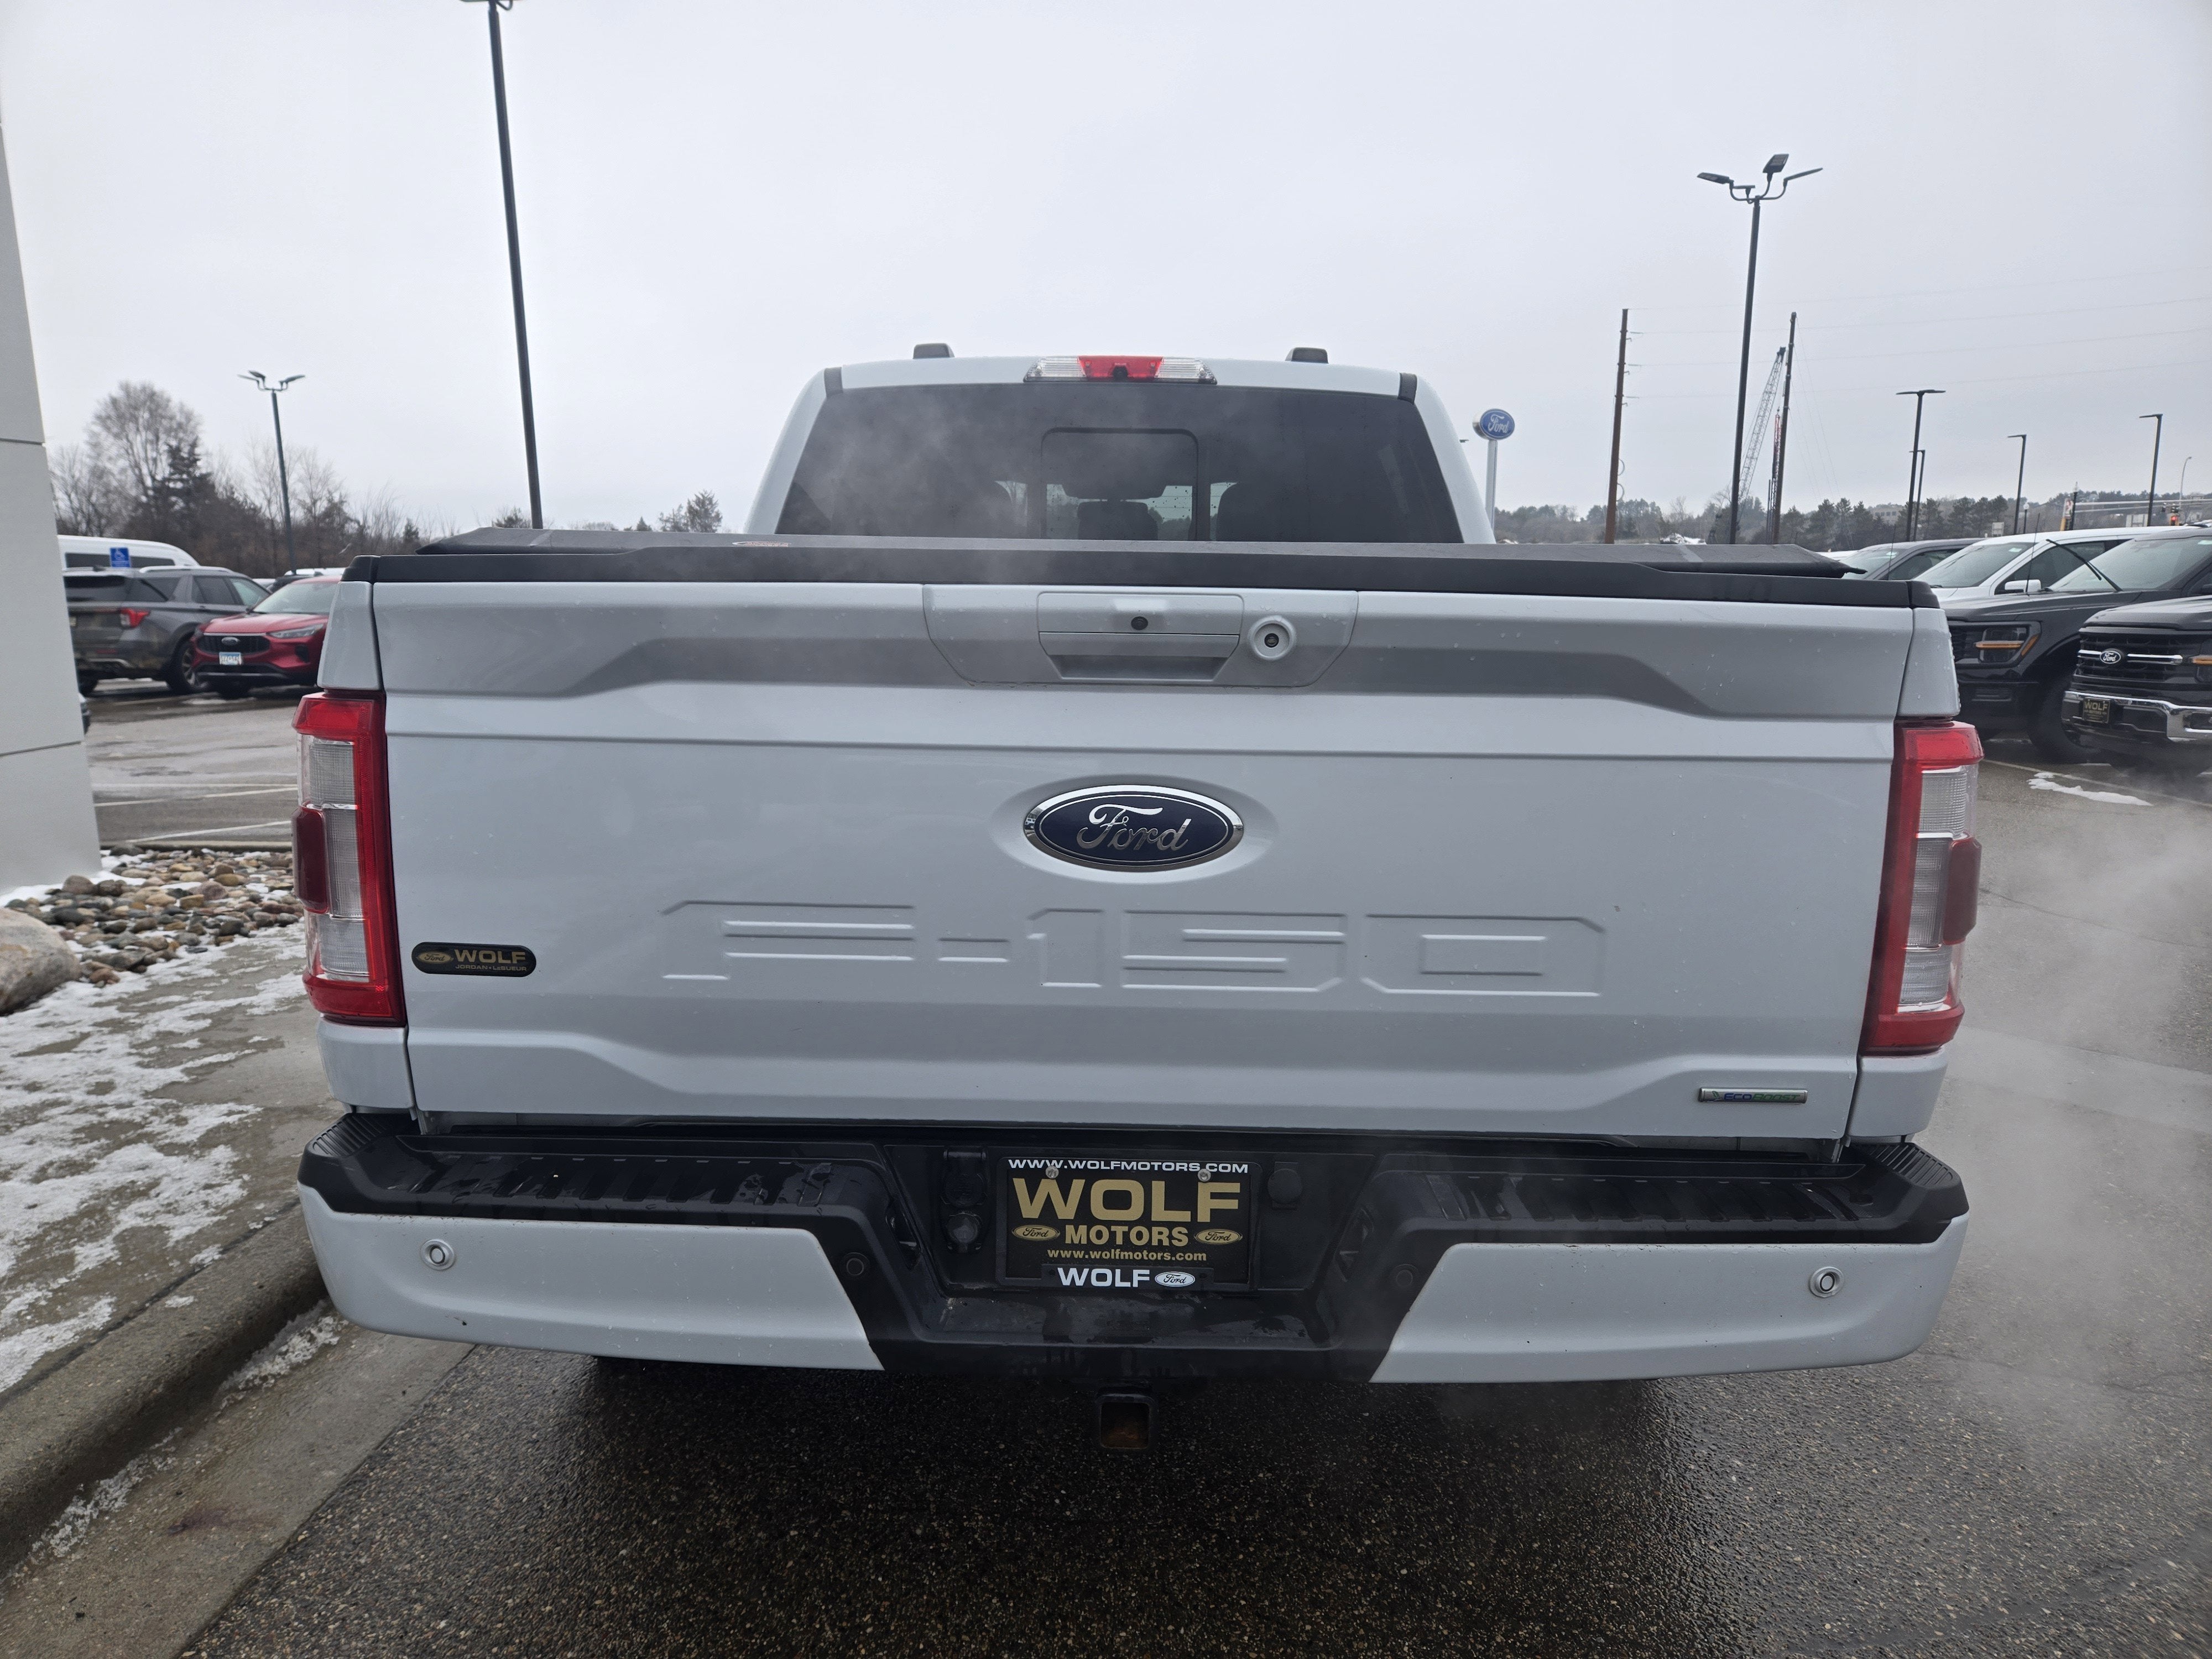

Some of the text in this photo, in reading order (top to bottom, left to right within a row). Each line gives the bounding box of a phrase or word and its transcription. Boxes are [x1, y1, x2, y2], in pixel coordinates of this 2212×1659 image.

[1488, 414, 1510, 433] Ford
[2103, 652, 2117, 661] Ford
[2085, 701, 2108, 711] WOLF
[1076, 804, 1192, 851] Ford
[454, 949, 525, 964] WOLF
[1008, 1159, 1248, 1173] WWW.WOLFMOTORSCOM
[1013, 1177, 1241, 1223] WOLF
[1022, 1224, 1232, 1246] Ford MOTORS Ford
[1047, 1249, 1207, 1261] www.wolfmotors.com
[1057, 1267, 1187, 1288] WOLF Ford
